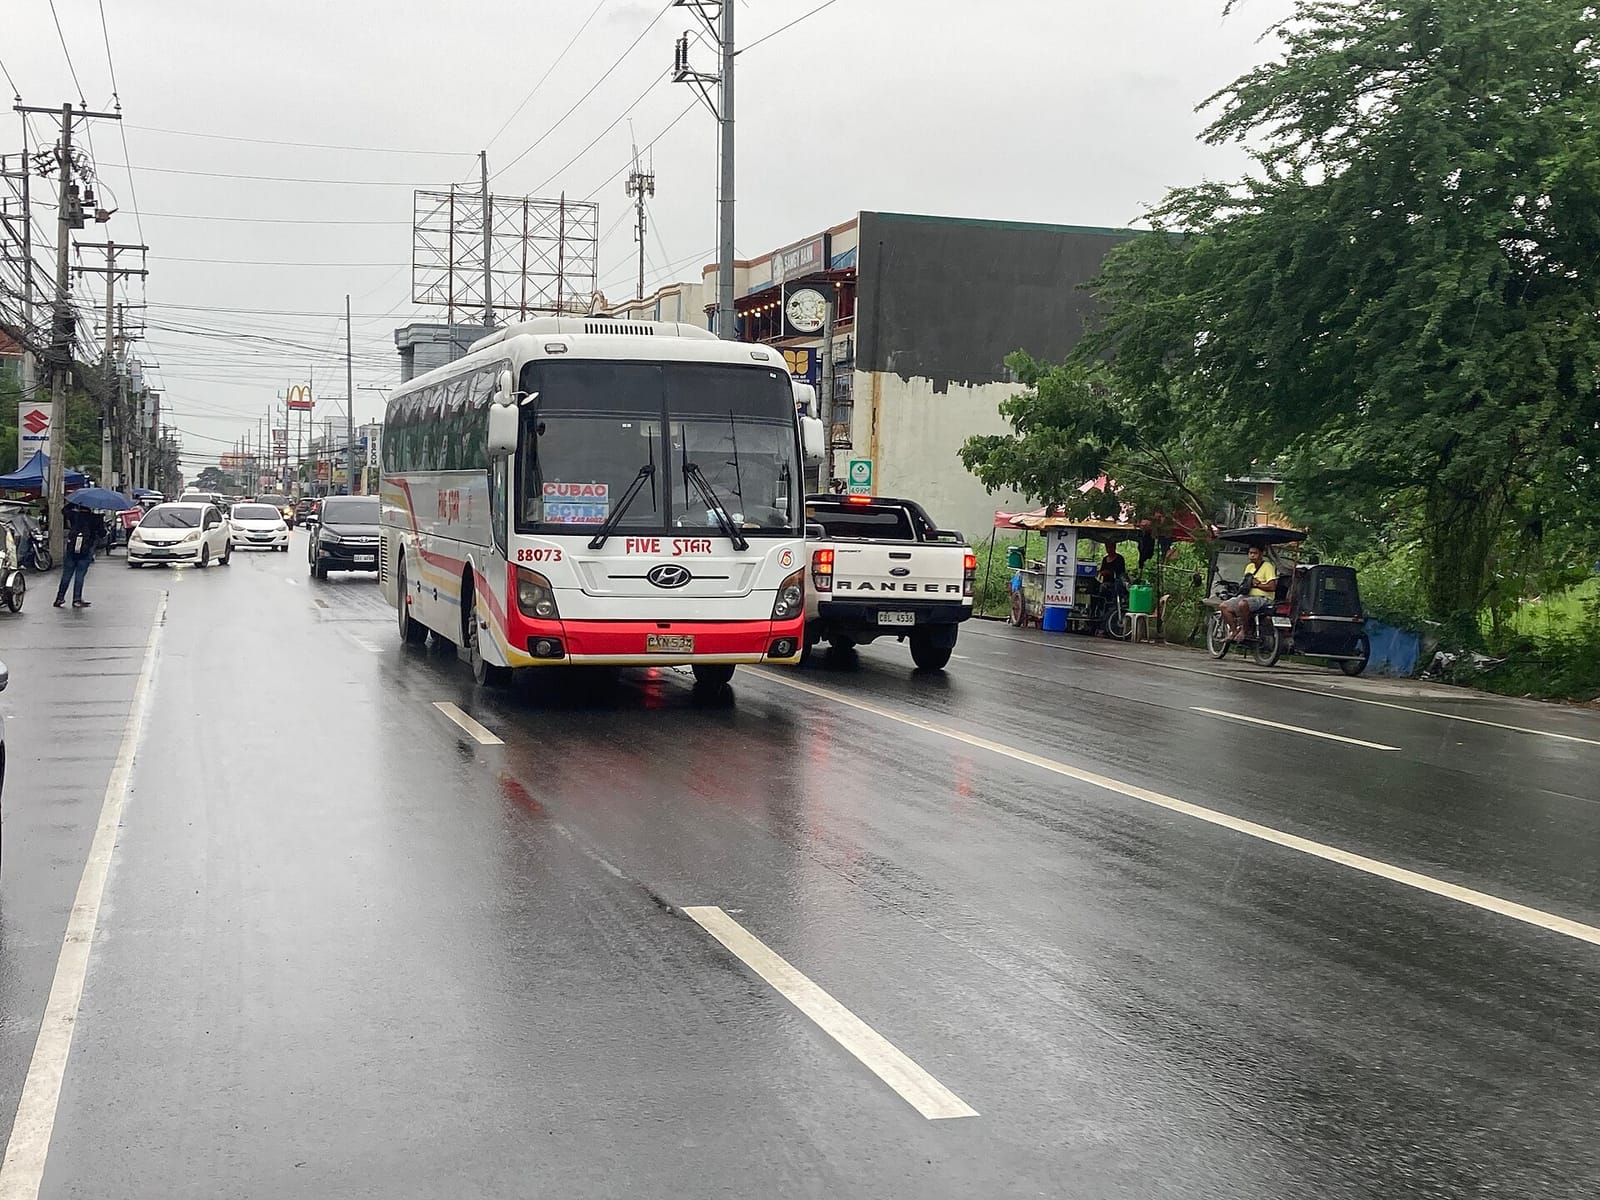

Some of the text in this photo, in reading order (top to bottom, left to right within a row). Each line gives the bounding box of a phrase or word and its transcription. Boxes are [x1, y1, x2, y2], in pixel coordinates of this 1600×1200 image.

[544, 484, 607, 496] CUBAO
[626, 538, 712, 556] FIVE STAR
[517, 549, 562, 561] 88073
[1054, 529, 1069, 590] PARES
[837, 581, 960, 593] RANGER
[1046, 594, 1072, 603] MAMI
[896, 614, 914, 623] 4536
